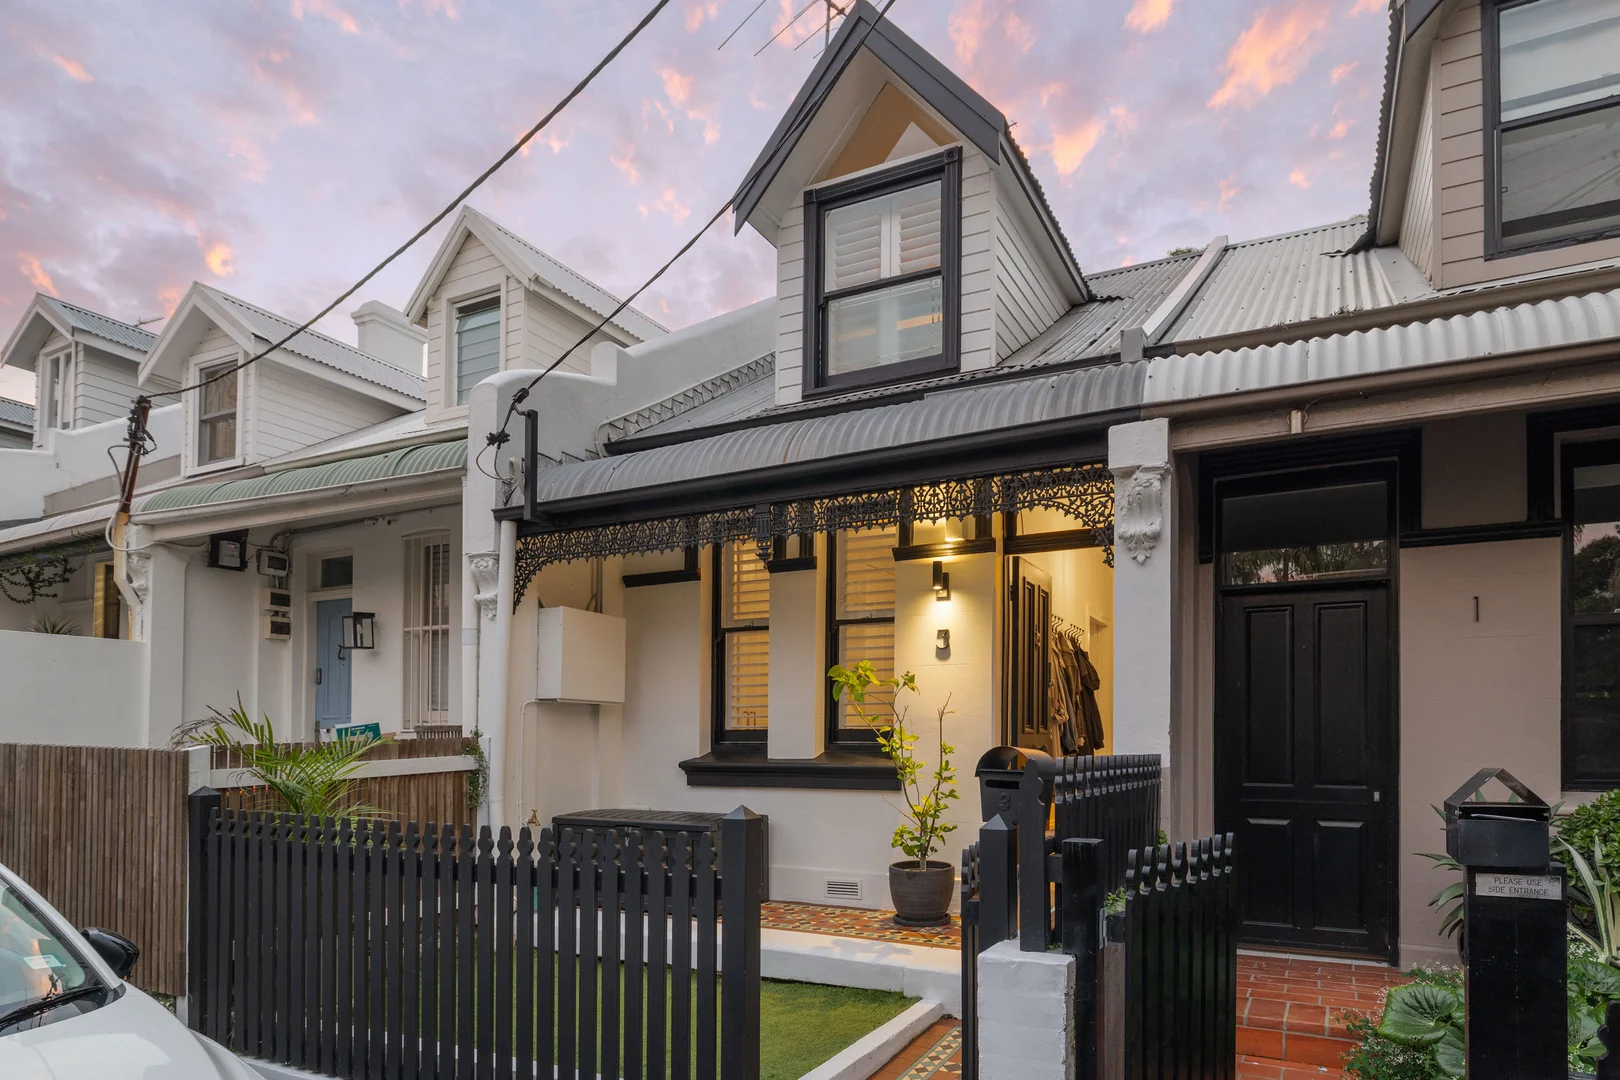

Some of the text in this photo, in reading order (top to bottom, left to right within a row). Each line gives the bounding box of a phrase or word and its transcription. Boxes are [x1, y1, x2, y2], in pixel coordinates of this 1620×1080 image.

[1473, 596, 1479, 622] 1
[935, 629, 950, 649] 3
[1000, 792, 1011, 812] 3
[1488, 886, 1549, 896] SIDE ENTRANCE
[1494, 876, 1543, 887] PLEASE USE
